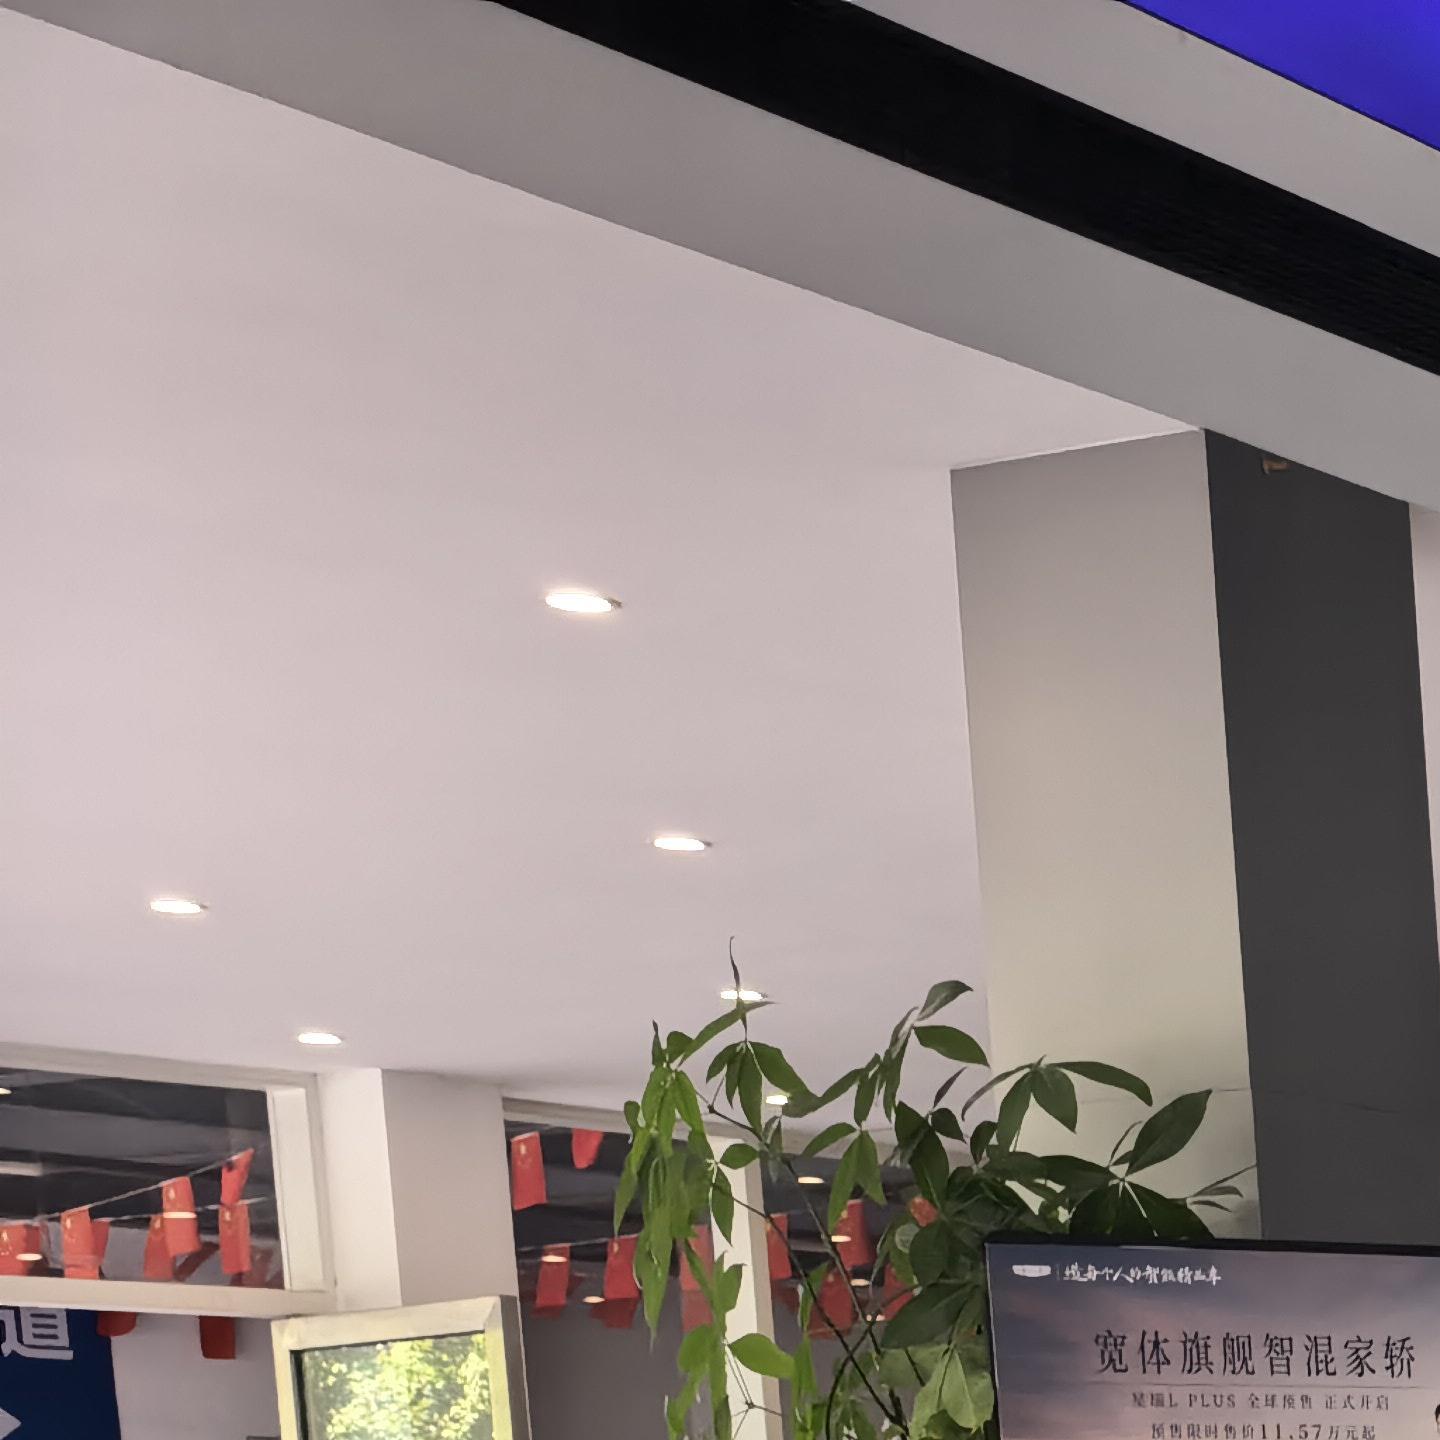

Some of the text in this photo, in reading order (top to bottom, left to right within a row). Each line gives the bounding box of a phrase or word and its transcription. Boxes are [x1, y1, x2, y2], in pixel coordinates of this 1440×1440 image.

[1095, 1329, 1416, 1379] 宽体旗舰智混家轿
[1188, 1392, 1236, 1408] PLUS
